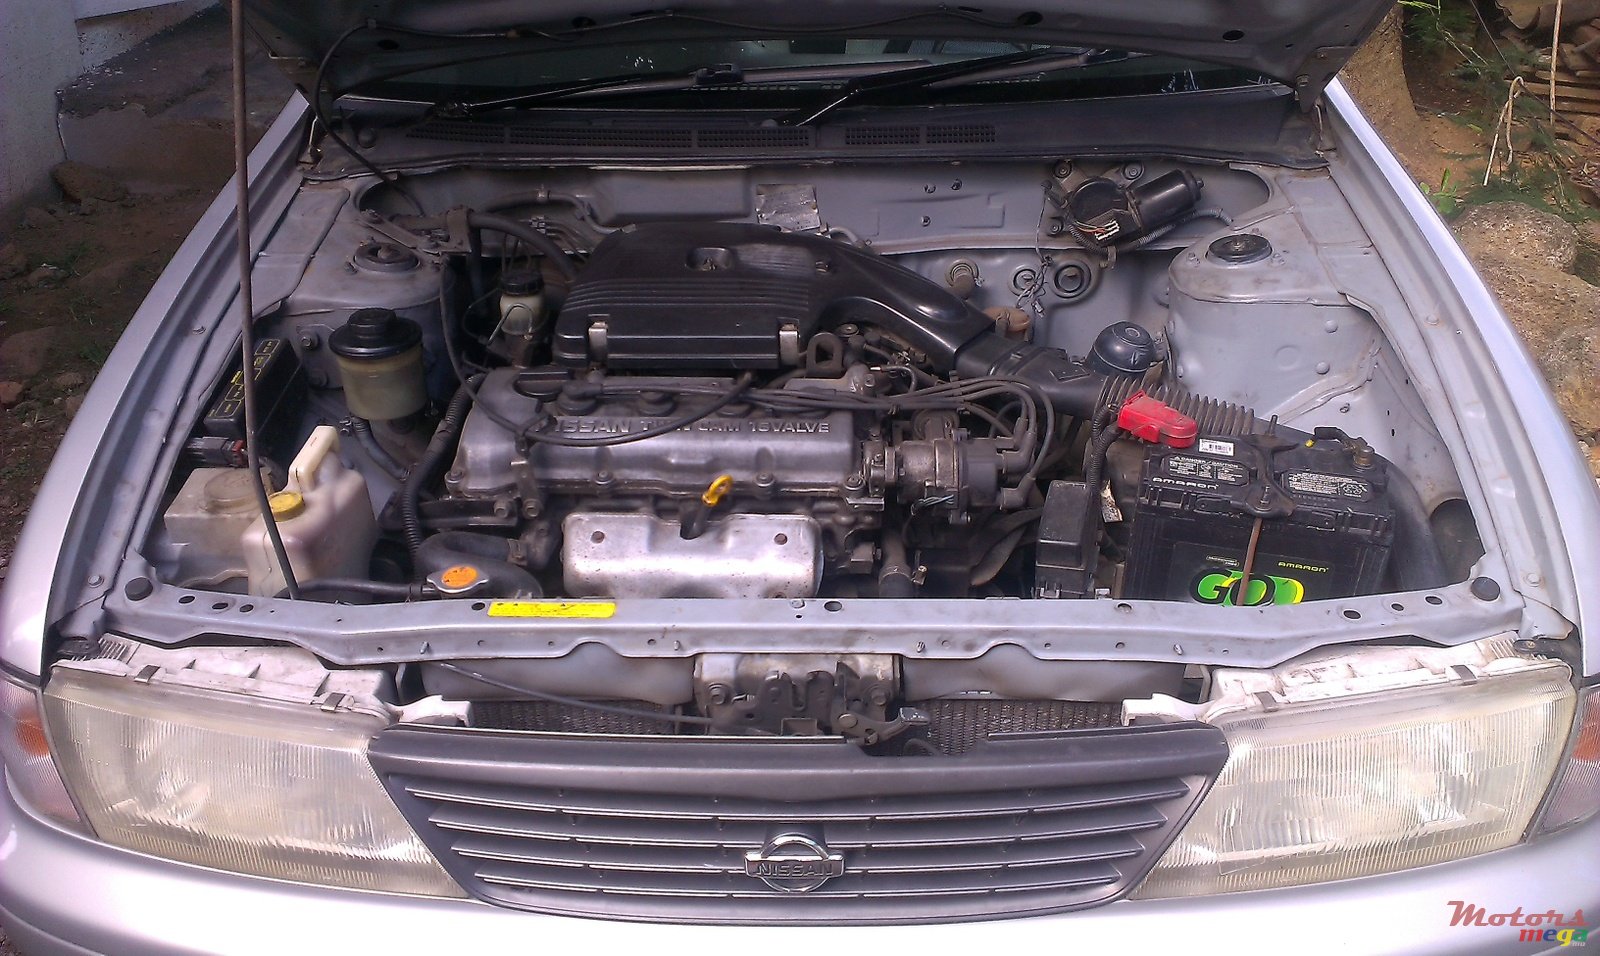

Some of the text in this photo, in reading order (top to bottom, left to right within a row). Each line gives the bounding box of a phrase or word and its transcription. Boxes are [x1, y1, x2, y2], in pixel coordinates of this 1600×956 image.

[535, 418, 633, 433] ISSAN
[698, 420, 741, 433] CAM
[755, 862, 833, 877] NISSAN
